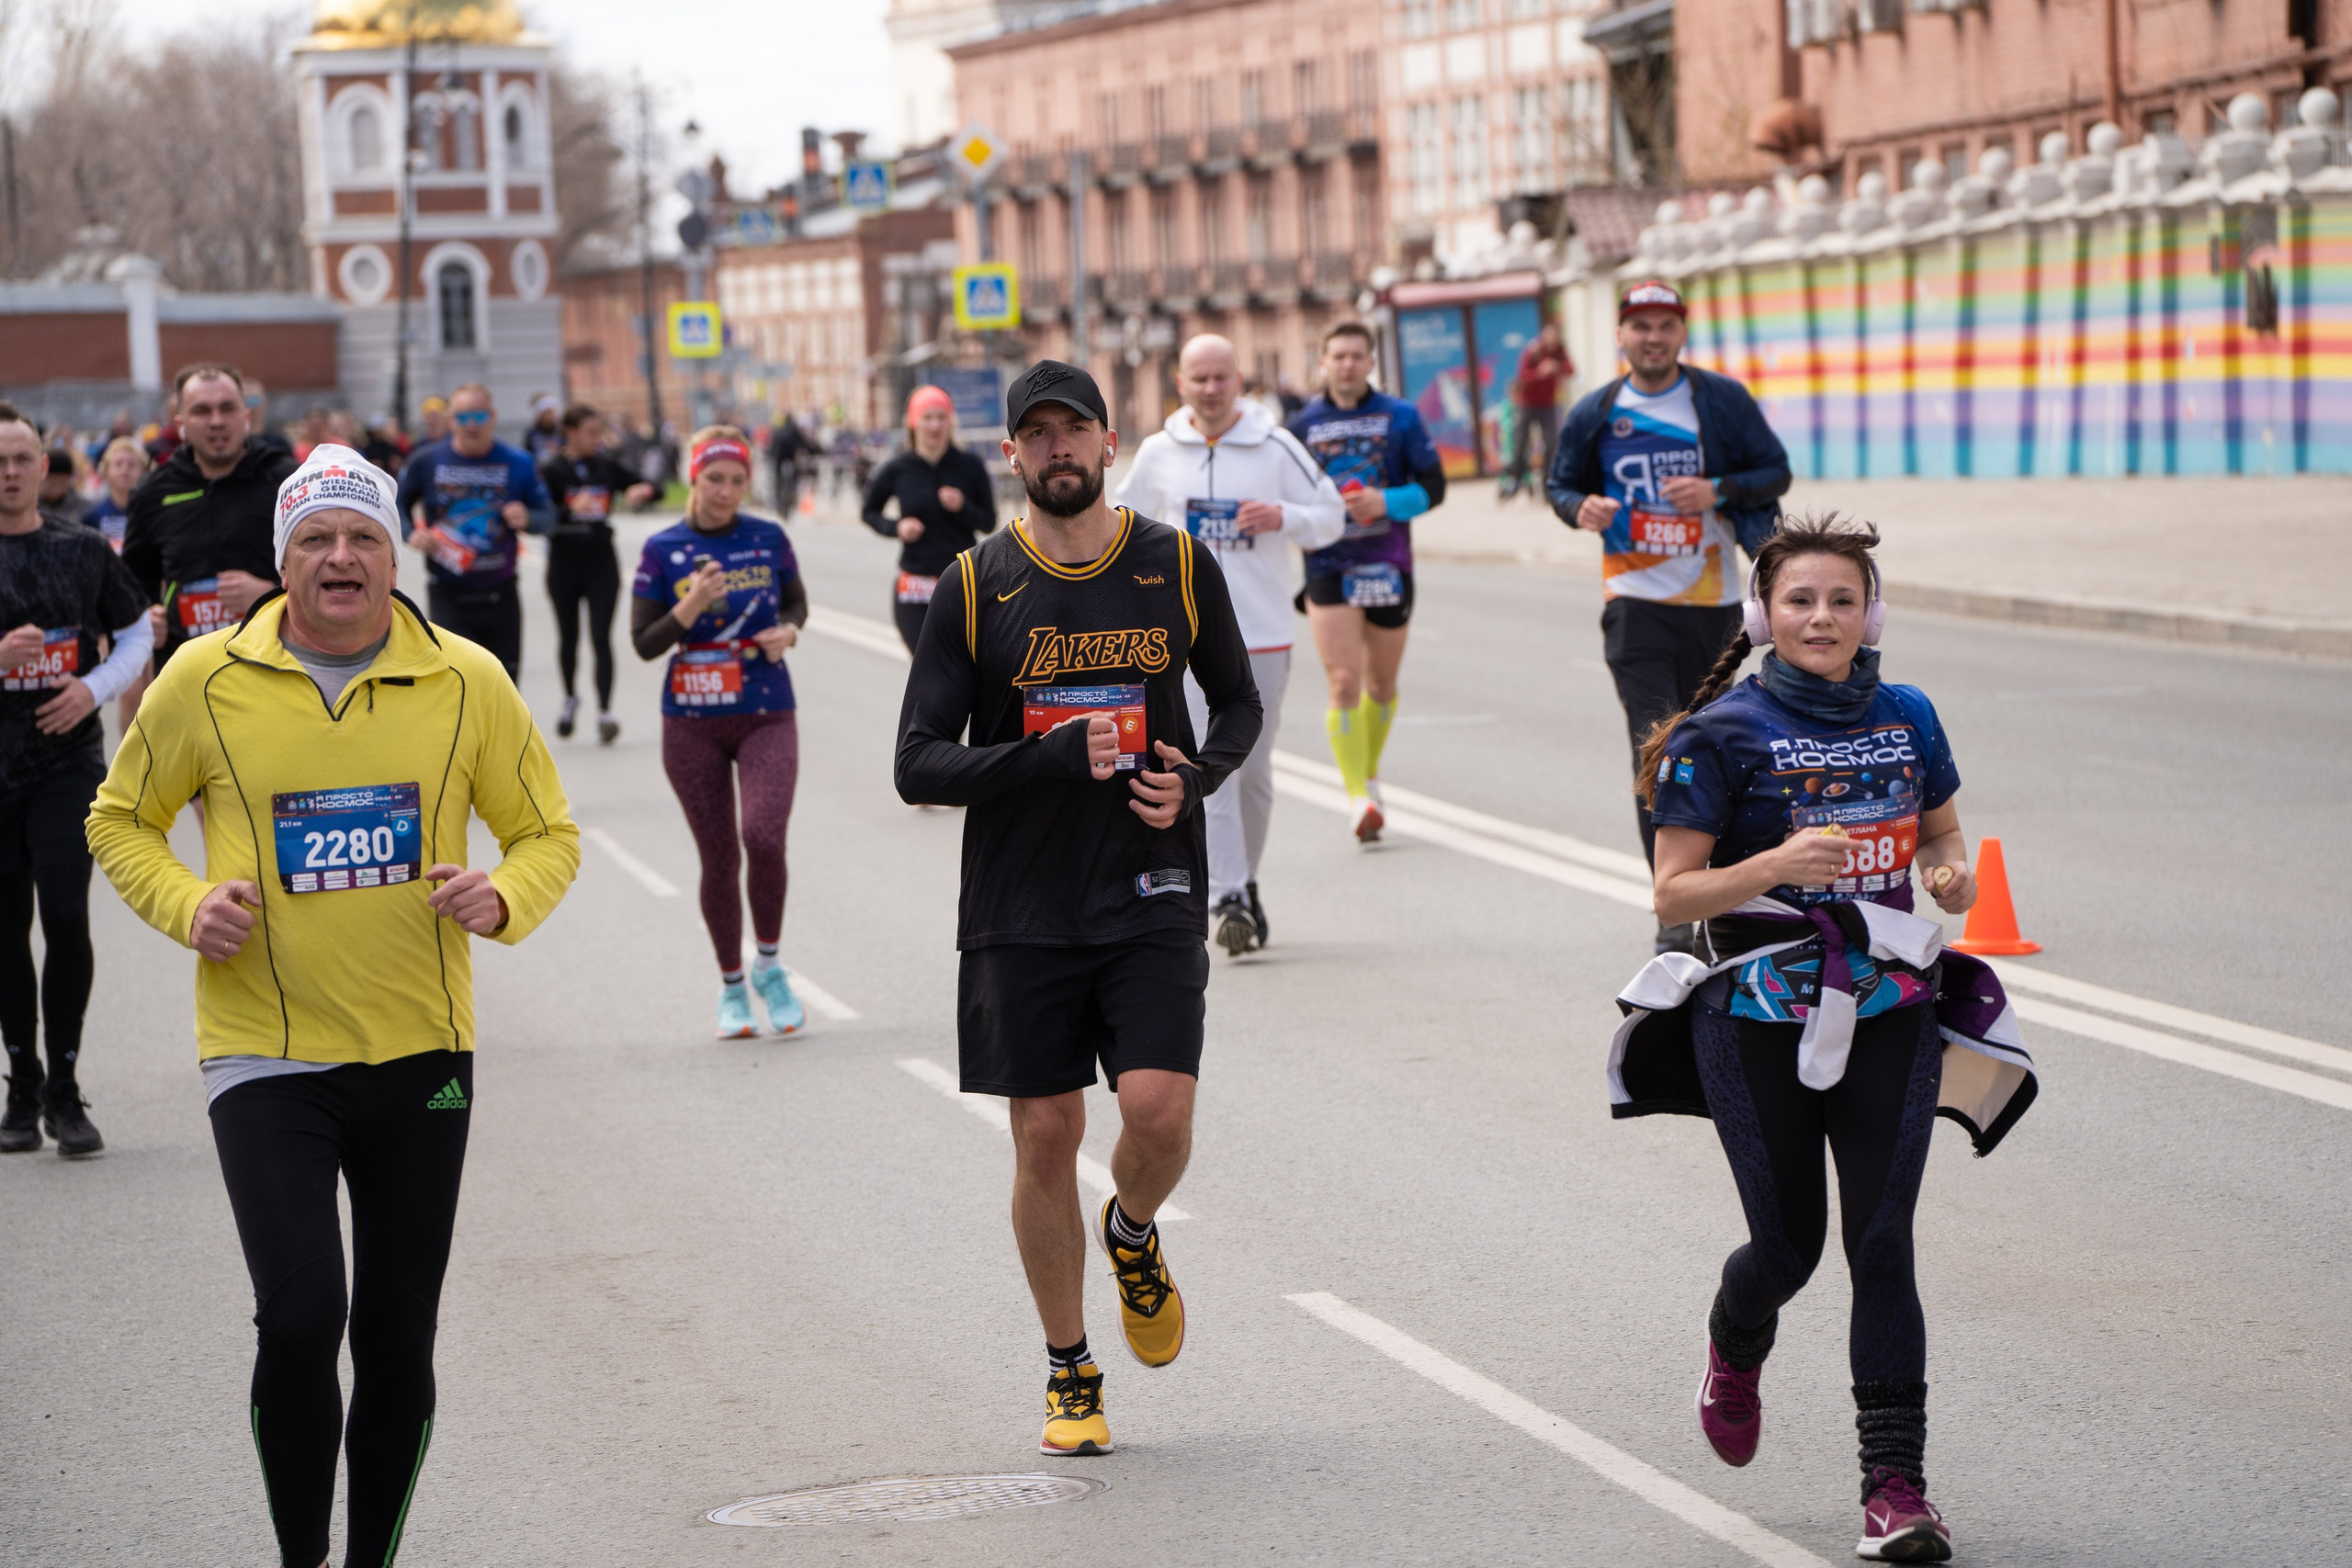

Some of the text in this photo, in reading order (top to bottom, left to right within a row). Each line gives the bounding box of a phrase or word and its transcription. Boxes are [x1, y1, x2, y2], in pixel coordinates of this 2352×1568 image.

[1653, 449, 1697, 466] ПРО
[320, 478, 380, 498] WIESBADEN
[320, 485, 380, 502] GERMANY
[313, 491, 381, 510] CHAMPIONSHIP
[1133, 574, 1165, 585] wish
[1012, 626, 1170, 686] LAKERS
[683, 671, 724, 694] 1156
[1770, 739, 1792, 751] Я
[1773, 746, 1917, 771] КОСМОС
[315, 798, 375, 809] КОСМОС
[324, 791, 374, 801] ПРОСТО
[1833, 811, 1885, 822] КОСМОС
[1841, 805, 1885, 815] ПРОСТО
[1846, 825, 1878, 836] ЕТЛАНА
[304, 826, 395, 869] 2280
[426, 1097, 469, 1110] adidas
